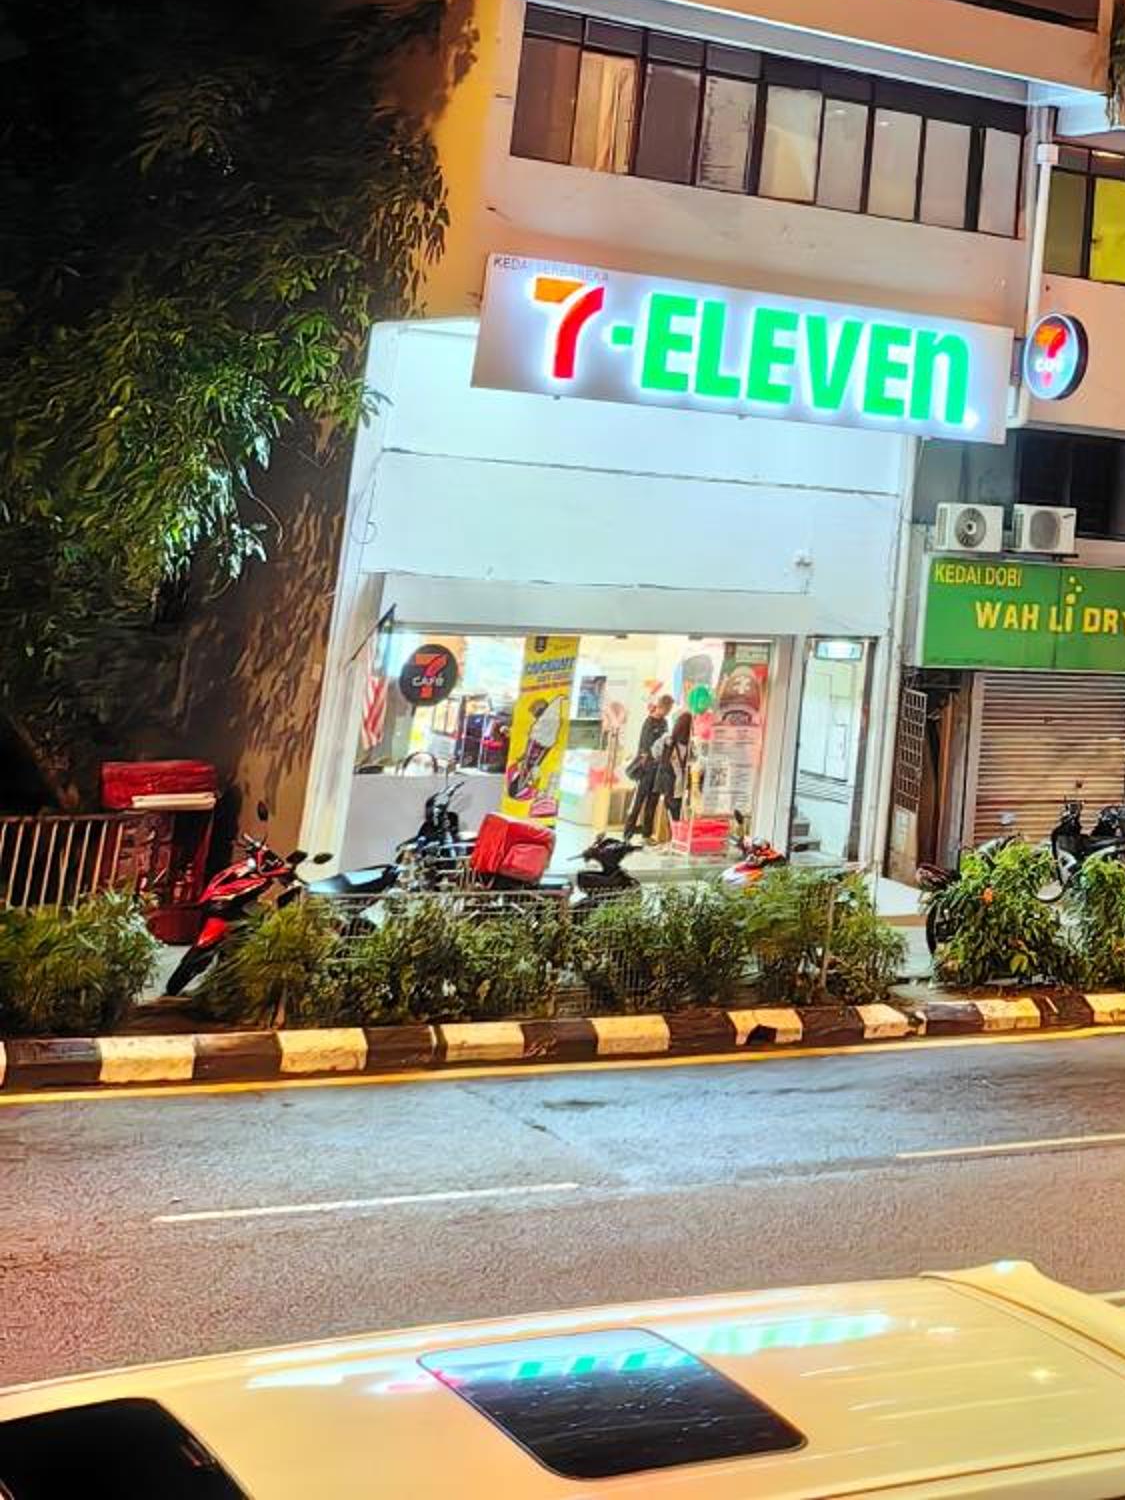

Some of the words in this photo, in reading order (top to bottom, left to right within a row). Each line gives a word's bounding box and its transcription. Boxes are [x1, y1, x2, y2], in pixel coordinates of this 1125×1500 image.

[934, 563, 982, 586] KEDAI
[984, 567, 1022, 588] DOBI
[975, 601, 1040, 631] WAH
